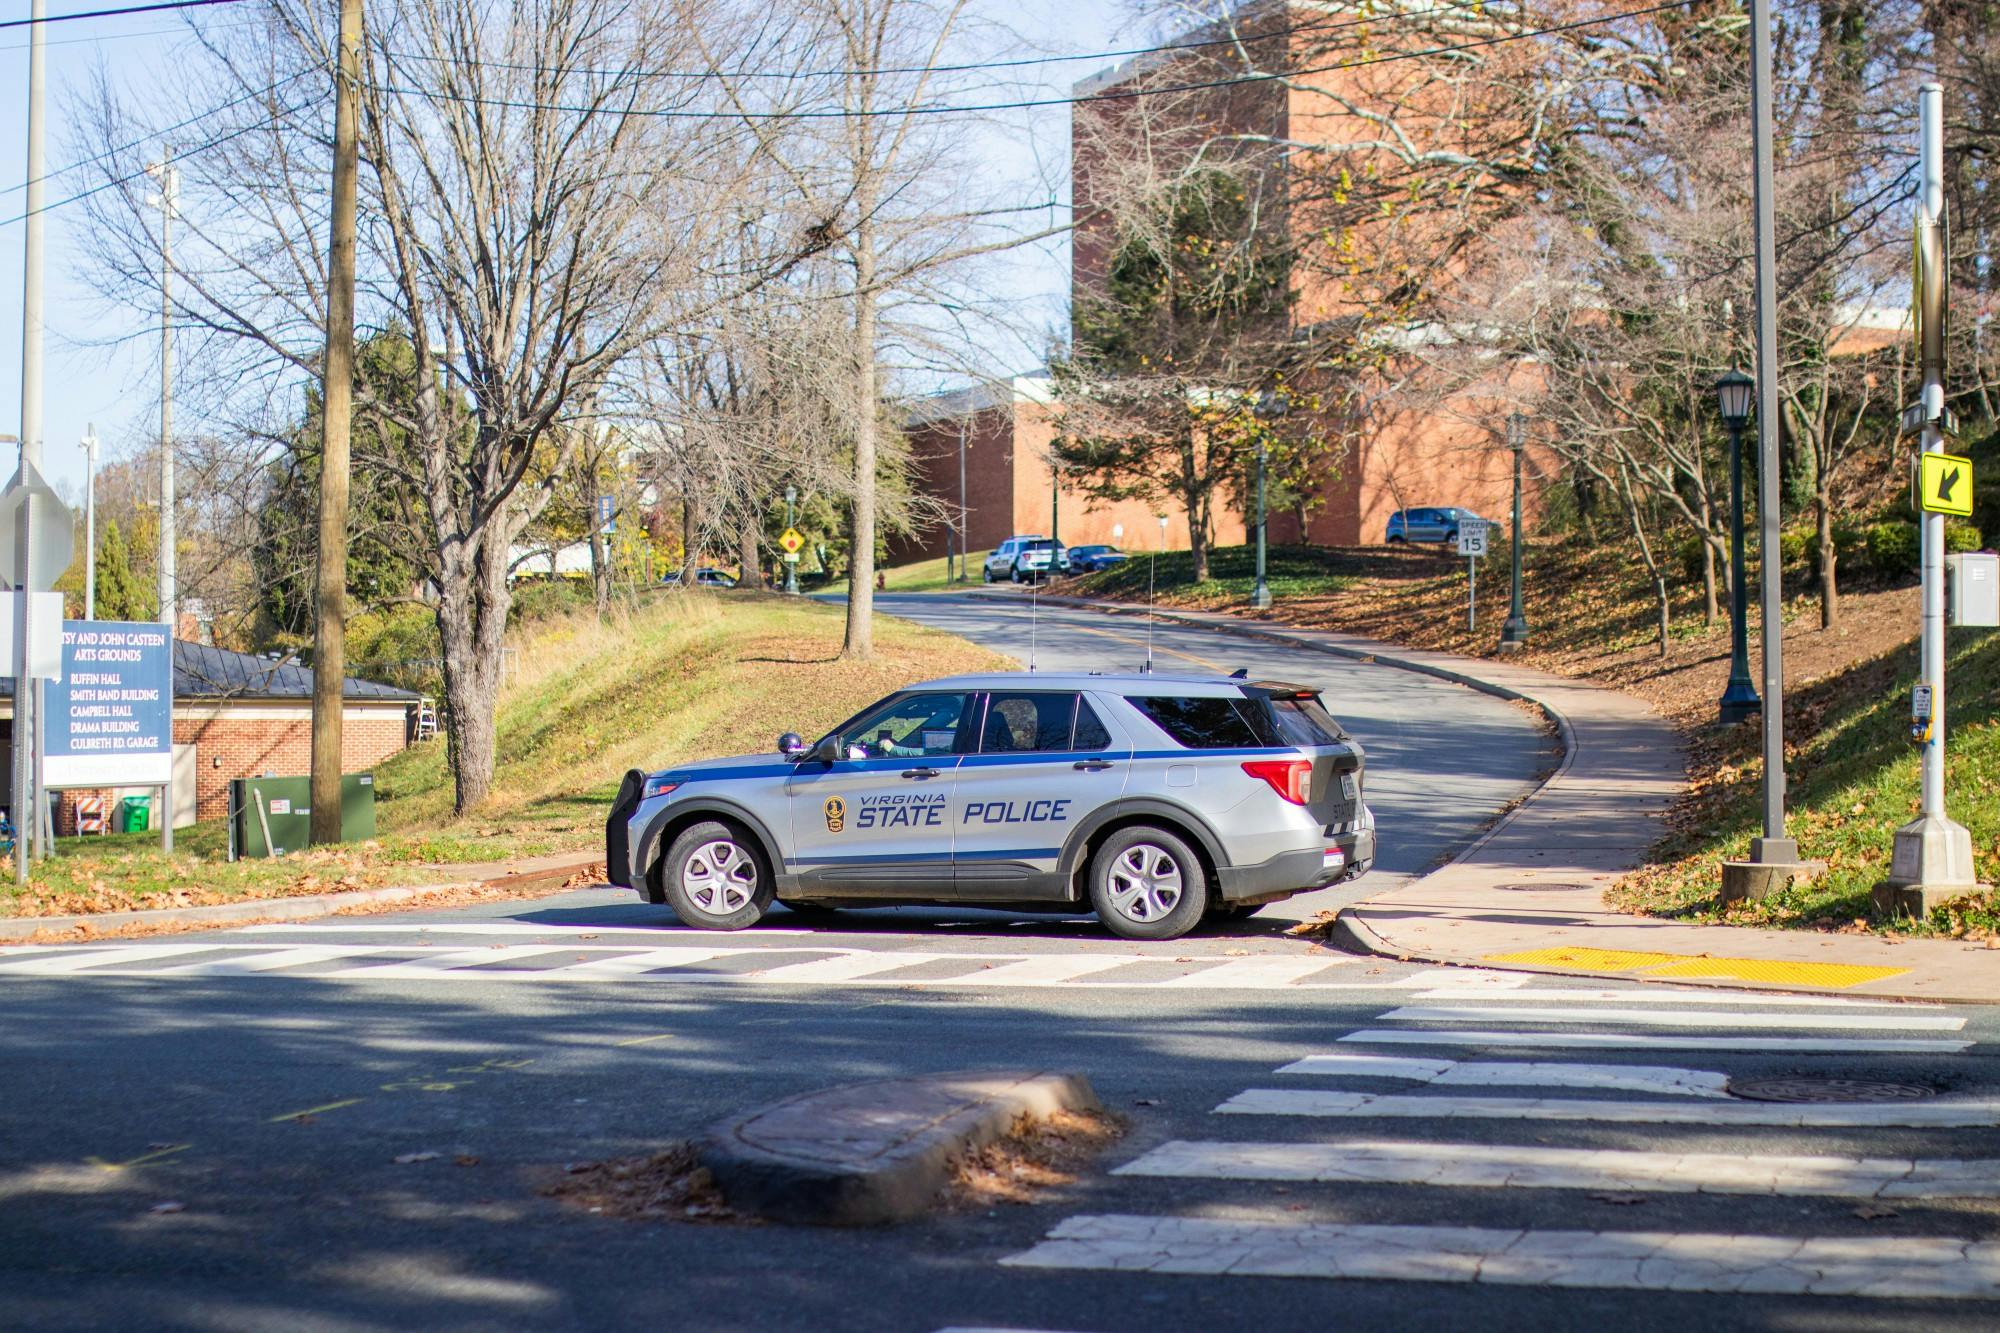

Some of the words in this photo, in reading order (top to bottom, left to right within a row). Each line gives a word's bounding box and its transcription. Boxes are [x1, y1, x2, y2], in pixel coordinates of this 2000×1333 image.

[1463, 529, 1483, 537] LIMIT
[1464, 538, 1482, 551] 15
[61, 631, 77, 645] TSY
[77, 631, 98, 645] AND
[99, 632, 126, 646] JOHN
[126, 633, 165, 646] CASTEEN
[74, 648, 96, 661] ARTS
[97, 649, 142, 662] GROUNDS
[70, 673, 100, 685] RUFFIN
[100, 673, 122, 685] HALL
[70, 689, 96, 701] SMITH
[97, 689, 121, 701] BAND
[121, 689, 159, 701] BUILDING
[70, 705, 111, 717] CAMPBELL
[112, 705, 133, 717] HALL
[70, 721, 101, 733] DRAMA
[101, 721, 140, 733] BUILDING
[70, 737, 112, 750] CULBRETH
[126, 736, 159, 749] GARAGE
[860, 793, 946, 806] VIRGINIA
[856, 804, 946, 828] STATE
[962, 799, 1072, 825] POLICE
